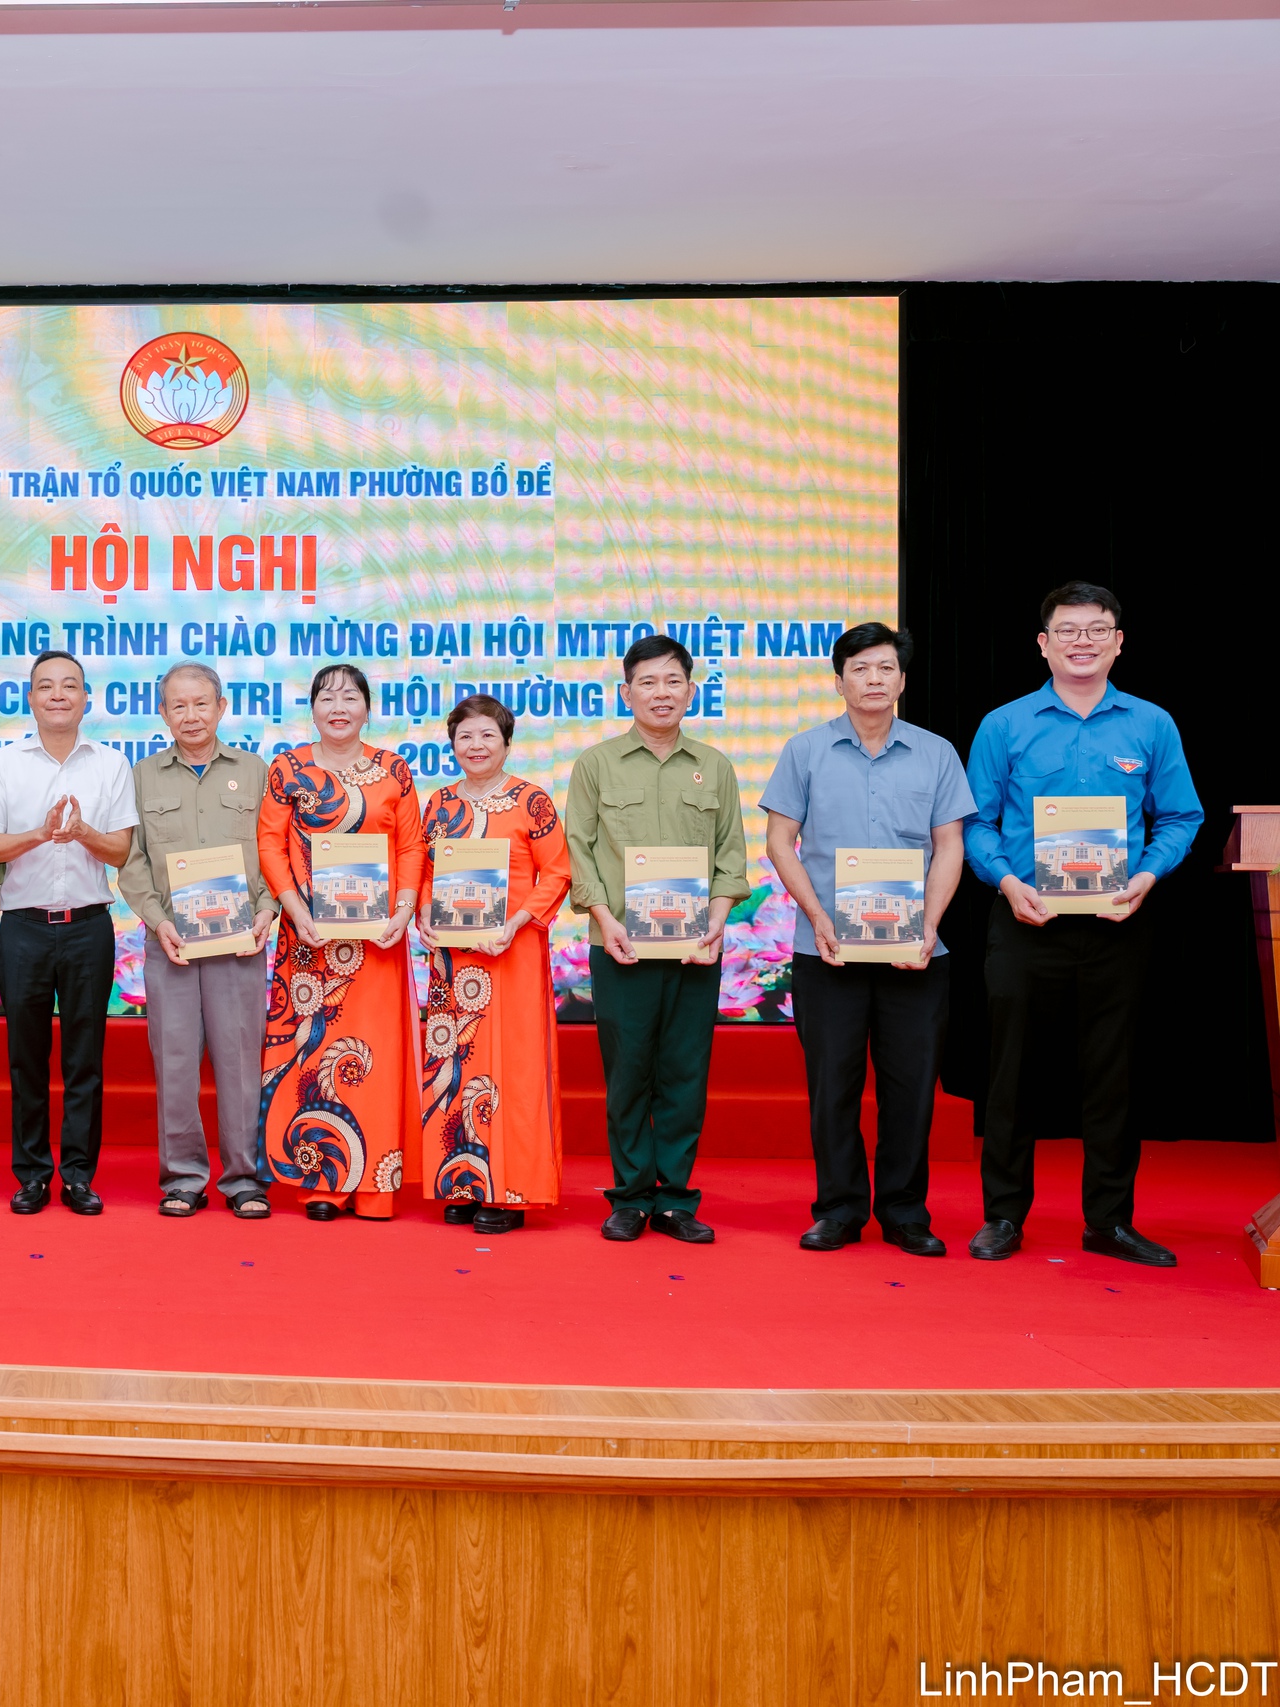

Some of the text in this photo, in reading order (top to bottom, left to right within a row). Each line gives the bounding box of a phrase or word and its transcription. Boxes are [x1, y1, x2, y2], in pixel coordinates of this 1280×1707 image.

[8, 466, 79, 503] TRẬN
[88, 461, 122, 498] TỔ
[130, 462, 202, 500] QUỐC
[211, 466, 268, 503] VIỆT
[277, 471, 340, 497] NAM
[350, 464, 463, 498] PHƯỜNG
[472, 461, 507, 497] BỒ
[517, 462, 553, 497] ĐỀ
[51, 522, 317, 605] HỘI NGHỊ
[62, 615, 168, 656] TRÌNH
[181, 615, 277, 657] CHÀO
[290, 615, 399, 657] MỪNG
[410, 622, 471, 664] ĐẠI
[484, 616, 544, 664] HỘI
[758, 622, 844, 657] NAM
[226, 682, 283, 724] TRỊ
[381, 675, 441, 724] HỘI
[397, 742, 462, 777] 203
